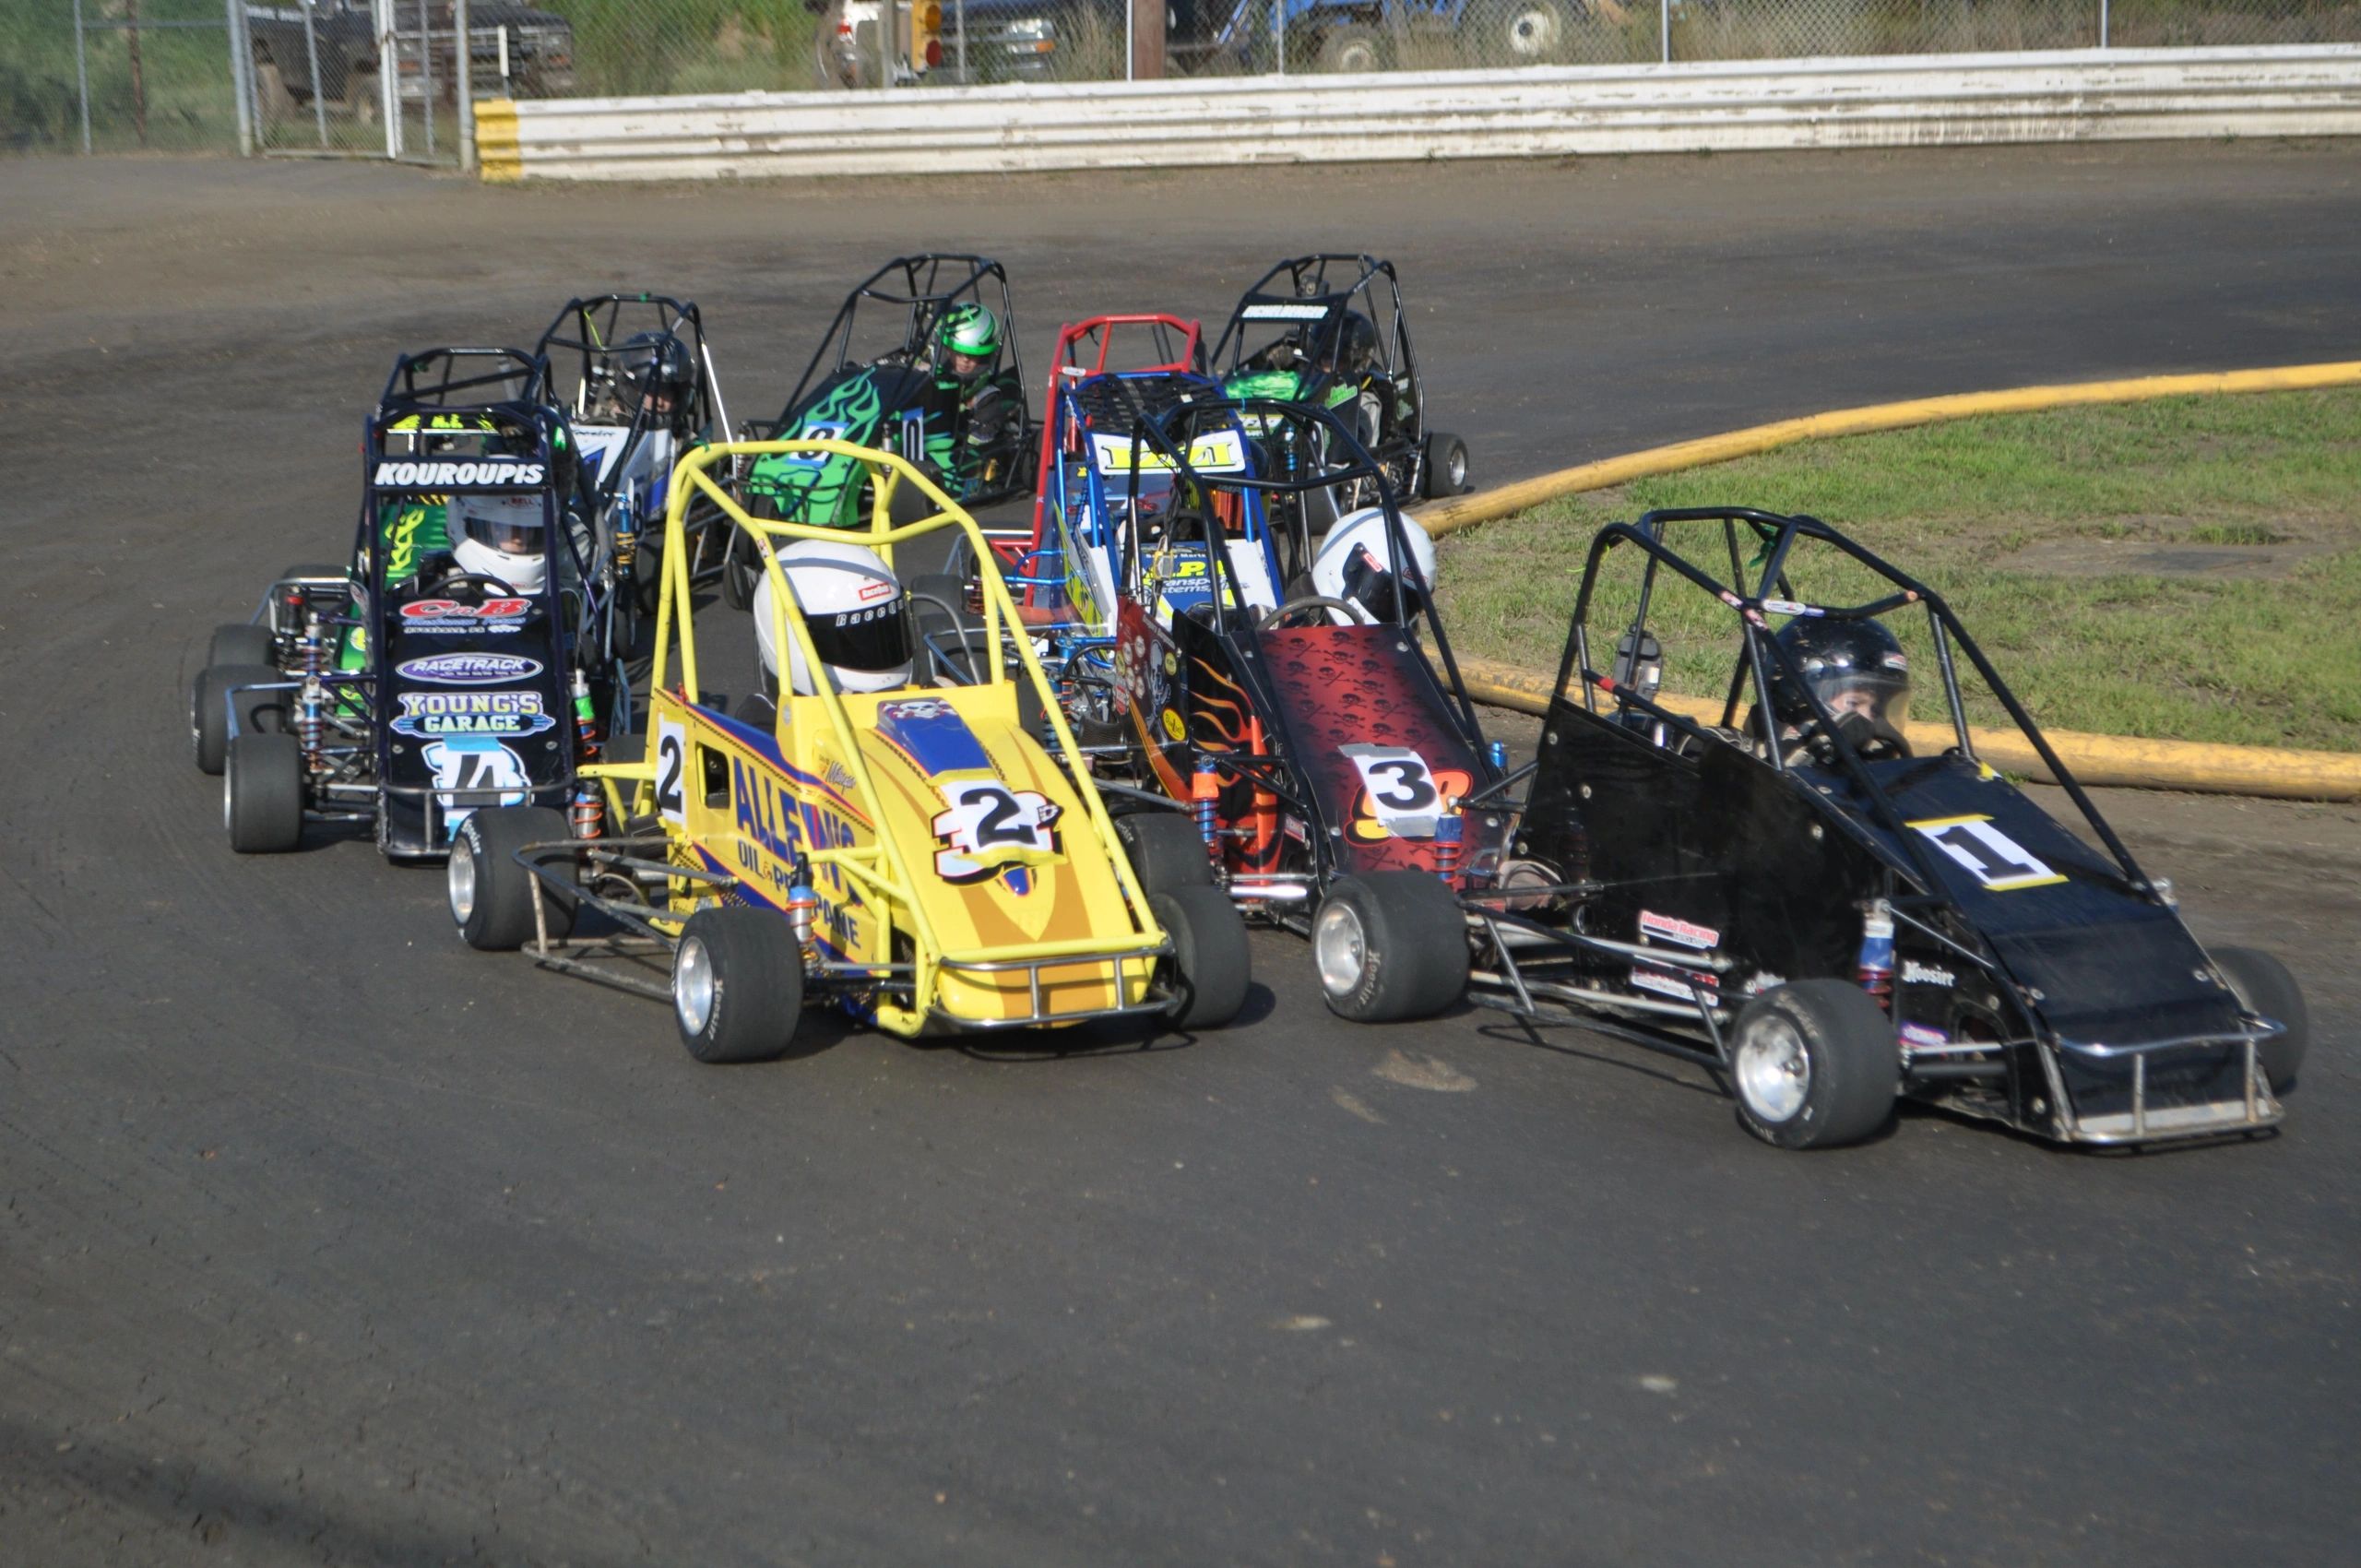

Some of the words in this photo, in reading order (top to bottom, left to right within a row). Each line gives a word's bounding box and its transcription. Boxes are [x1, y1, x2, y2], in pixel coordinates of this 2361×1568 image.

[374, 462, 546, 485] KOUROUPIS
[412, 659, 527, 672] RACETRACK
[404, 693, 538, 716] YOUNG'S
[424, 715, 521, 733] GARAGE
[659, 735, 682, 814] 2
[1369, 760, 1438, 812] 3
[960, 788, 1038, 849] 2
[738, 838, 765, 878] OIL
[1934, 826, 2039, 879] 1
